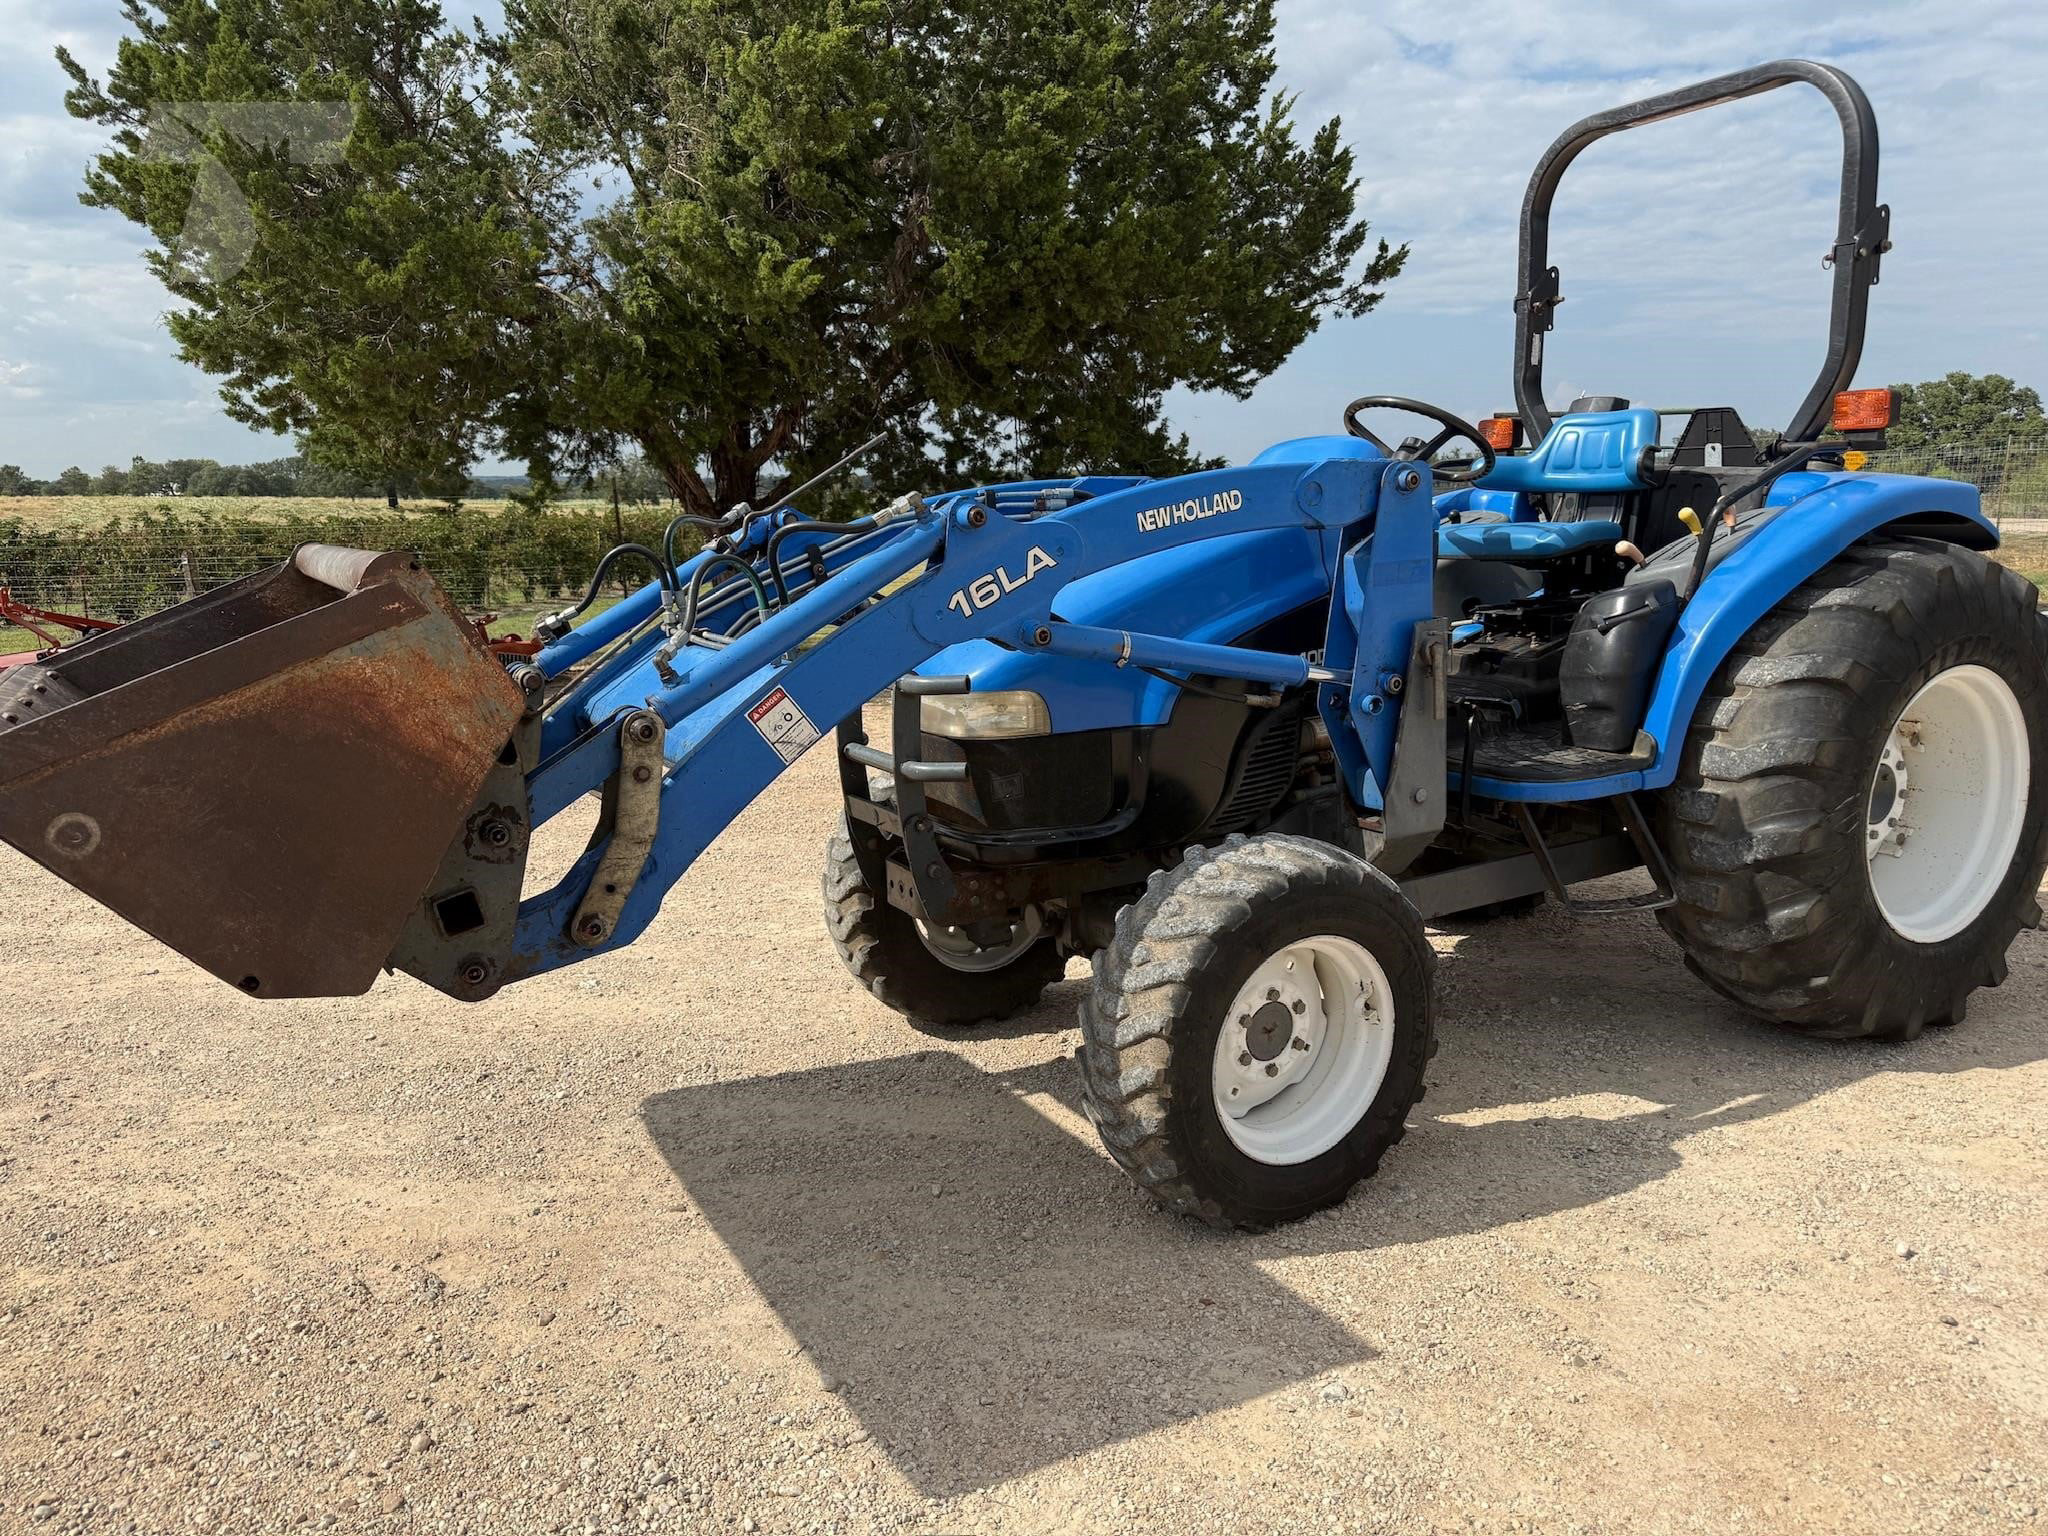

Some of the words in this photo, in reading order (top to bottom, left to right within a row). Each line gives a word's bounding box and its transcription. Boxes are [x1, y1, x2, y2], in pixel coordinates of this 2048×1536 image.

[1136, 507, 1171, 533] NEW
[1173, 490, 1242, 524] HOLLAND
[948, 545, 1057, 618] 16LA
[757, 691, 783, 715] DANGER
